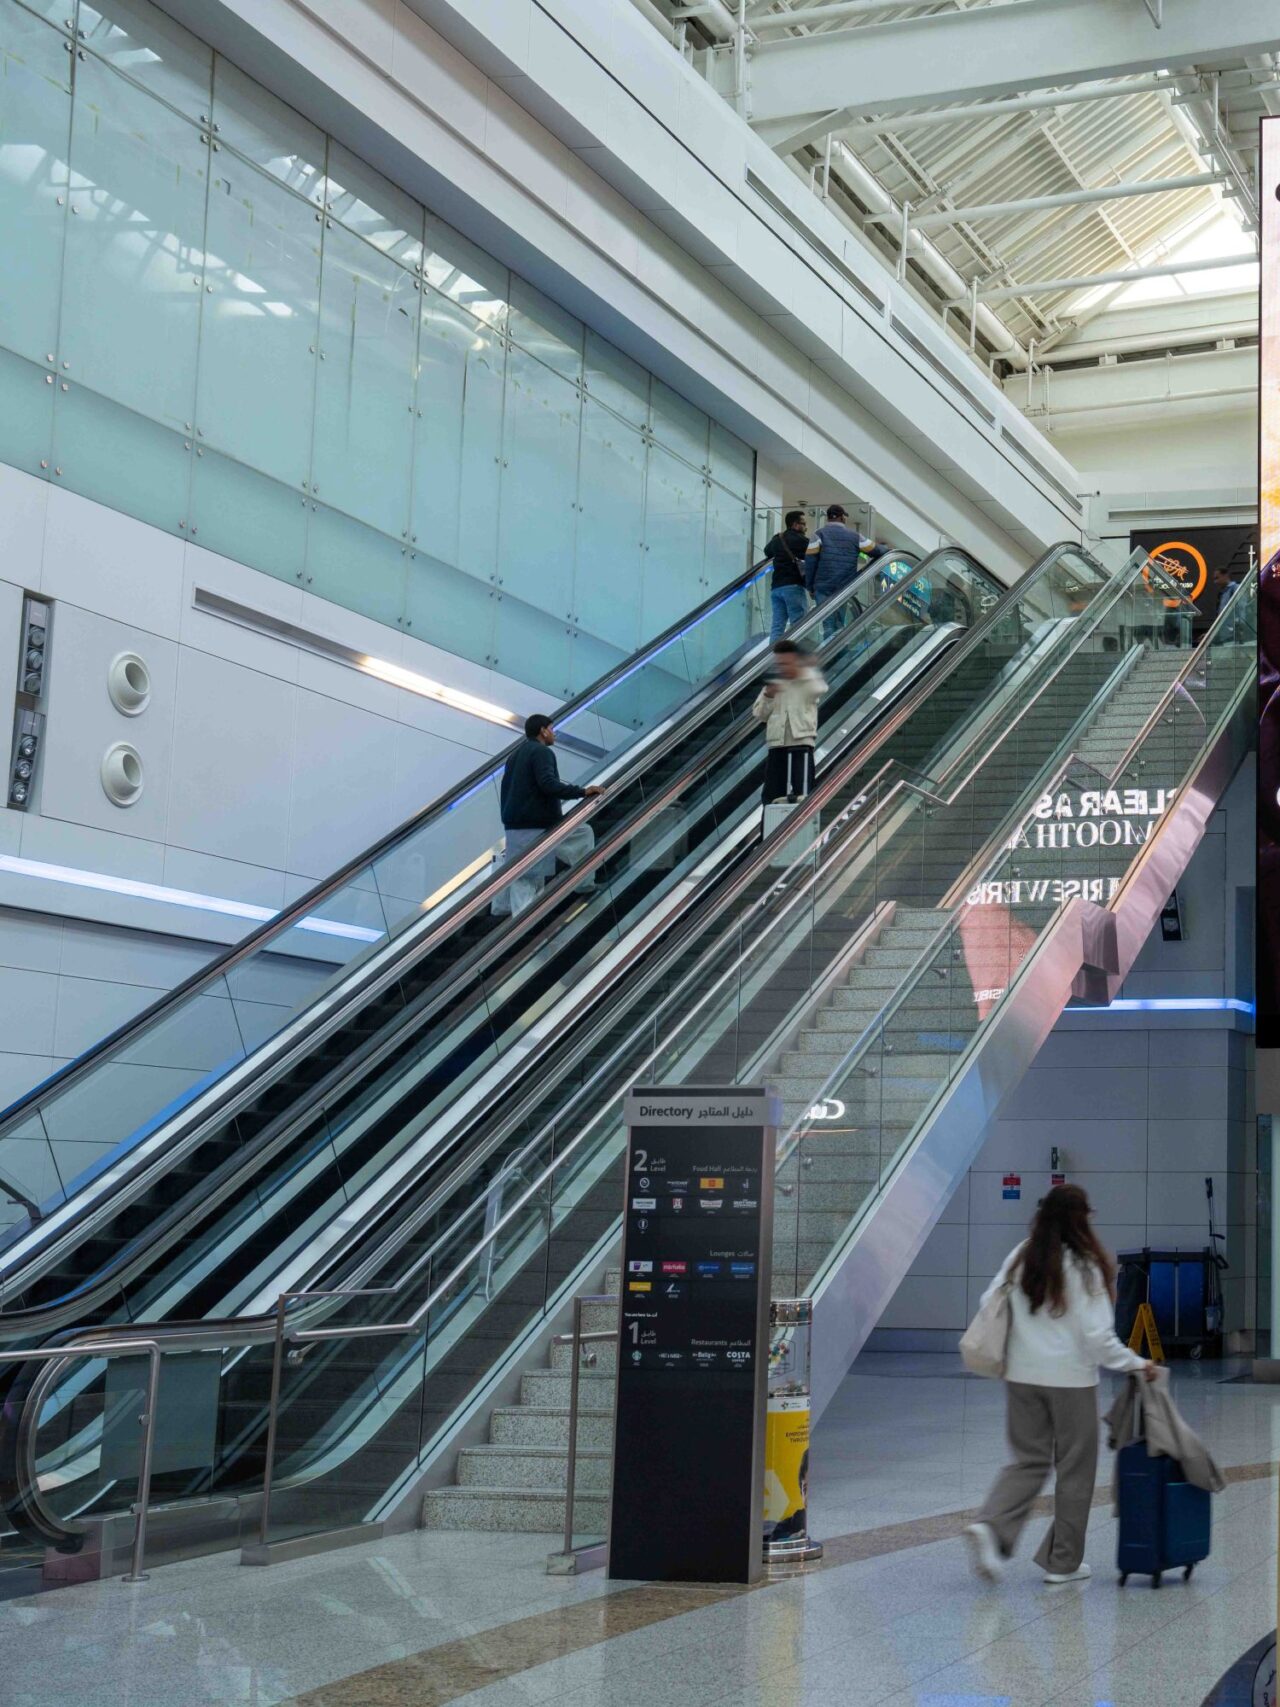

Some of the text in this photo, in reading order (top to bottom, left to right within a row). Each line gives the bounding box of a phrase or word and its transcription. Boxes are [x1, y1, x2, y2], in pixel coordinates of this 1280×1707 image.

[639, 1105, 694, 1120] Directory
[698, 1107, 753, 1119] دليل المتاجر
[633, 1149, 648, 1172] 2
[709, 1250, 736, 1258] Lounges
[628, 1321, 639, 1344] 1
[726, 1351, 751, 1359] COSTA
